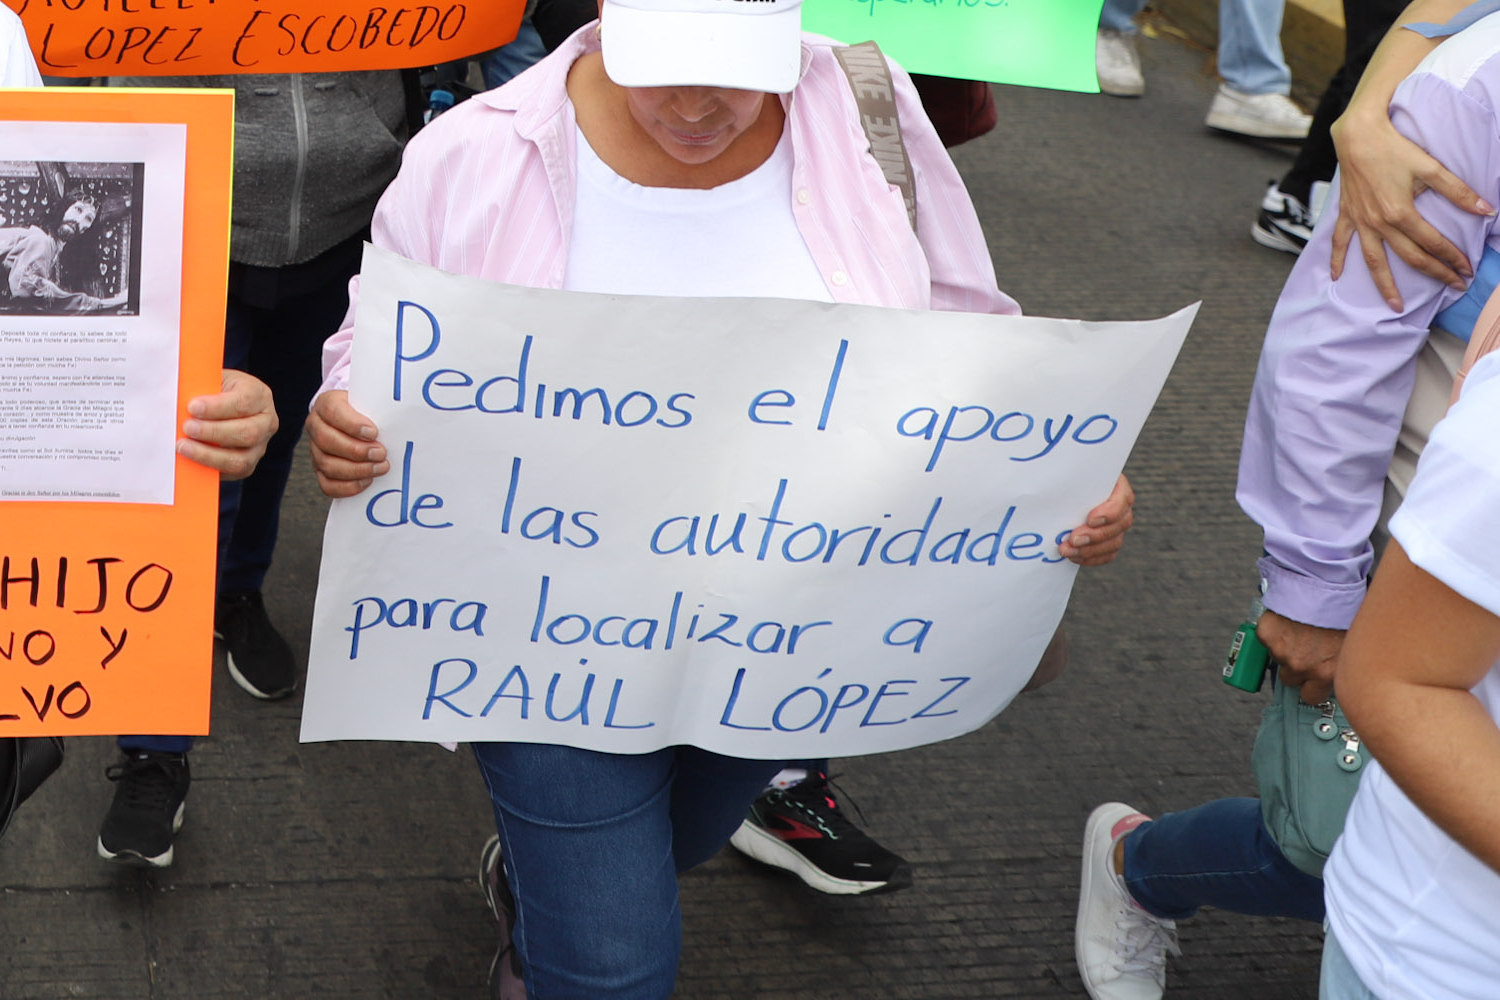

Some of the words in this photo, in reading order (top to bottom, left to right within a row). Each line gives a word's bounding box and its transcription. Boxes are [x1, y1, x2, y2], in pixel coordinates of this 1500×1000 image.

[41, 22, 204, 69] LOPEZ
[232, 3, 467, 67] ESCOBEDO
[392, 299, 696, 430] Pedimos
[747, 338, 849, 431] el
[896, 400, 1118, 472] apoyo
[364, 440, 454, 530] de
[501, 456, 600, 549] las
[649, 478, 1070, 568] autoridades
[0, 556, 174, 615] HIJO
[344, 594, 487, 661] para
[530, 575, 832, 656] localizar
[882, 615, 933, 654] a
[422, 656, 656, 731] RAÚL
[719, 666, 971, 735] LÓPEZ
